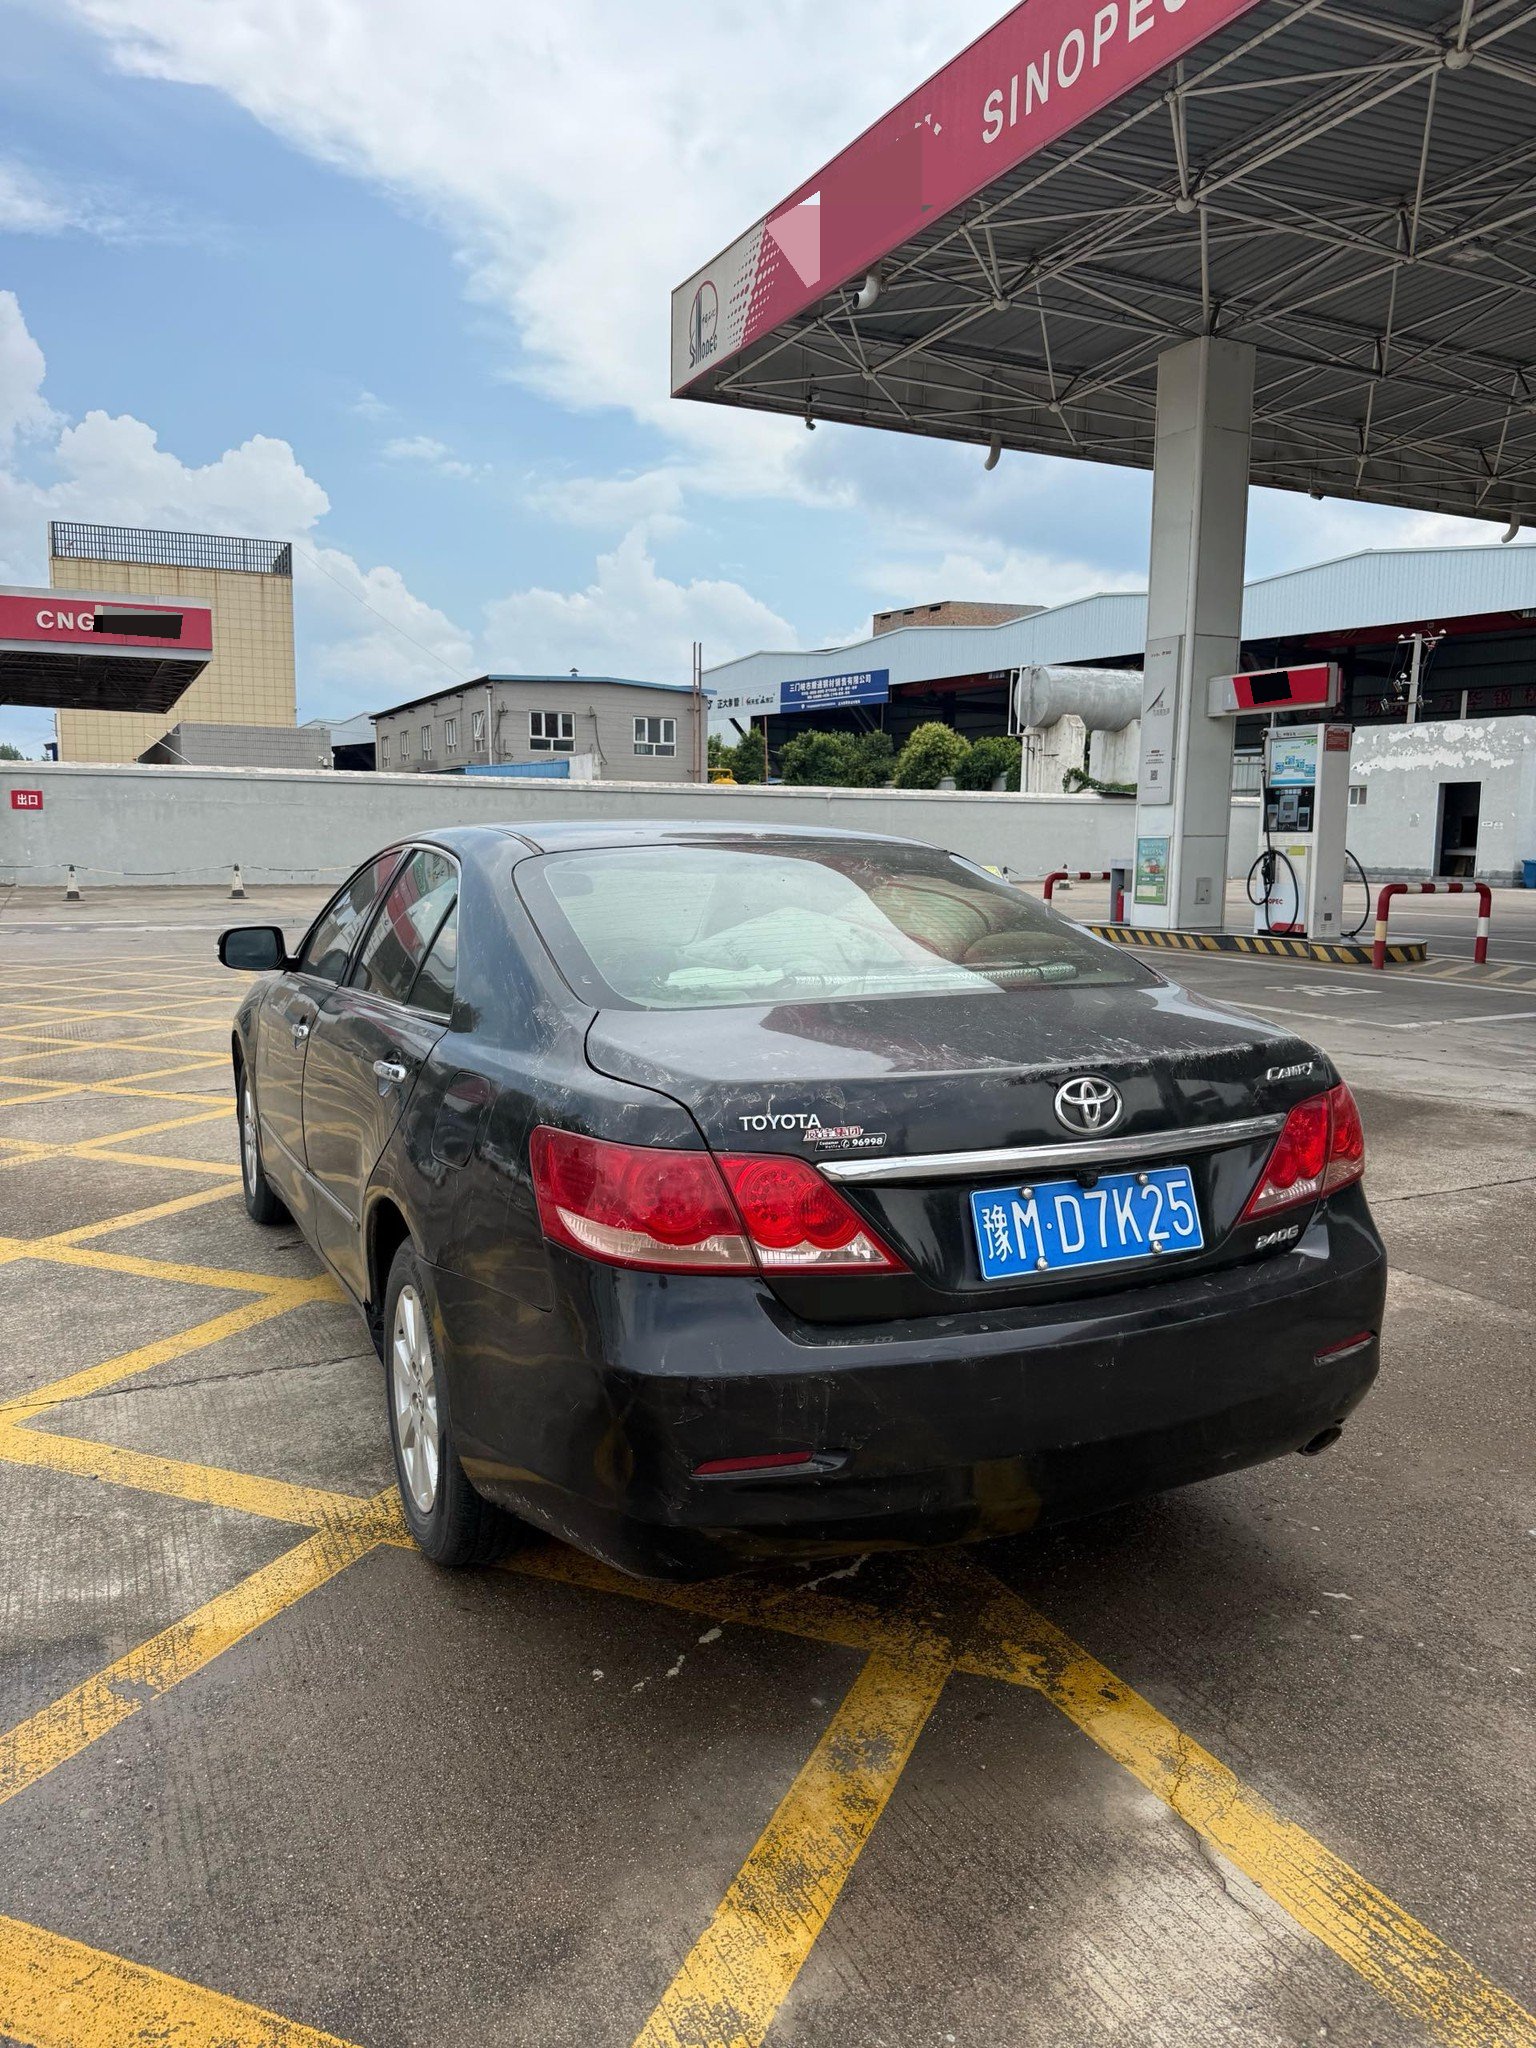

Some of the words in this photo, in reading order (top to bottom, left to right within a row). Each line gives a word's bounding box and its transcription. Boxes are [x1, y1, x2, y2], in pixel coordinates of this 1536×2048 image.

[982, 0, 1188, 144] SINOPE
[36, 610, 94, 631] CNG
[17, 793, 38, 806] 出口
[739, 1113, 821, 1131] TOYOTA
[852, 1137, 883, 1147] 96998
[1255, 1224, 1299, 1250] 240G
